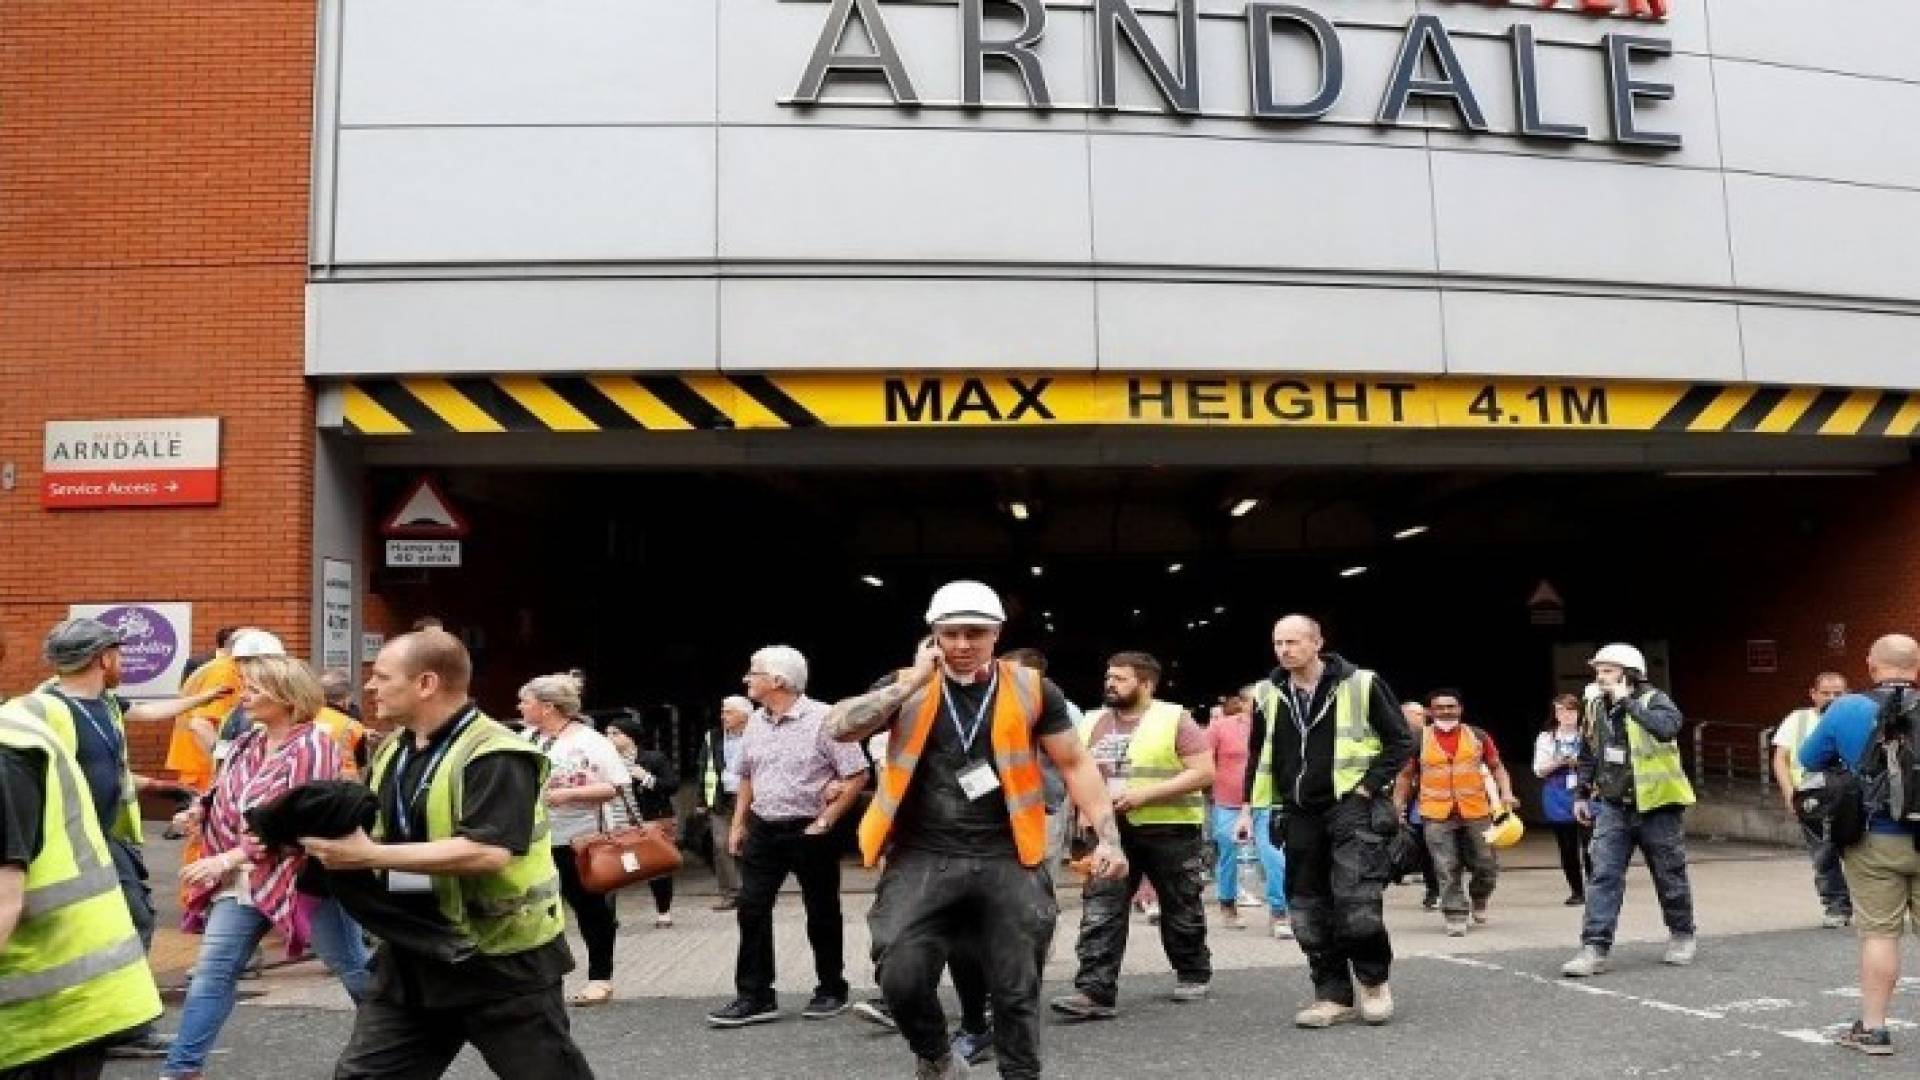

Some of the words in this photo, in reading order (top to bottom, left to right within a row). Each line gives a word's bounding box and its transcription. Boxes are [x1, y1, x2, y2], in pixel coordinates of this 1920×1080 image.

[793, 0, 1683, 151] ARNDALE
[885, 377, 1056, 421] MAX
[1128, 378, 1416, 422] HEIGHT
[1467, 384, 1610, 425] 4.1M
[53, 439, 182, 460] ARNDALE
[49, 482, 103, 497] Service
[107, 481, 157, 495] Access
